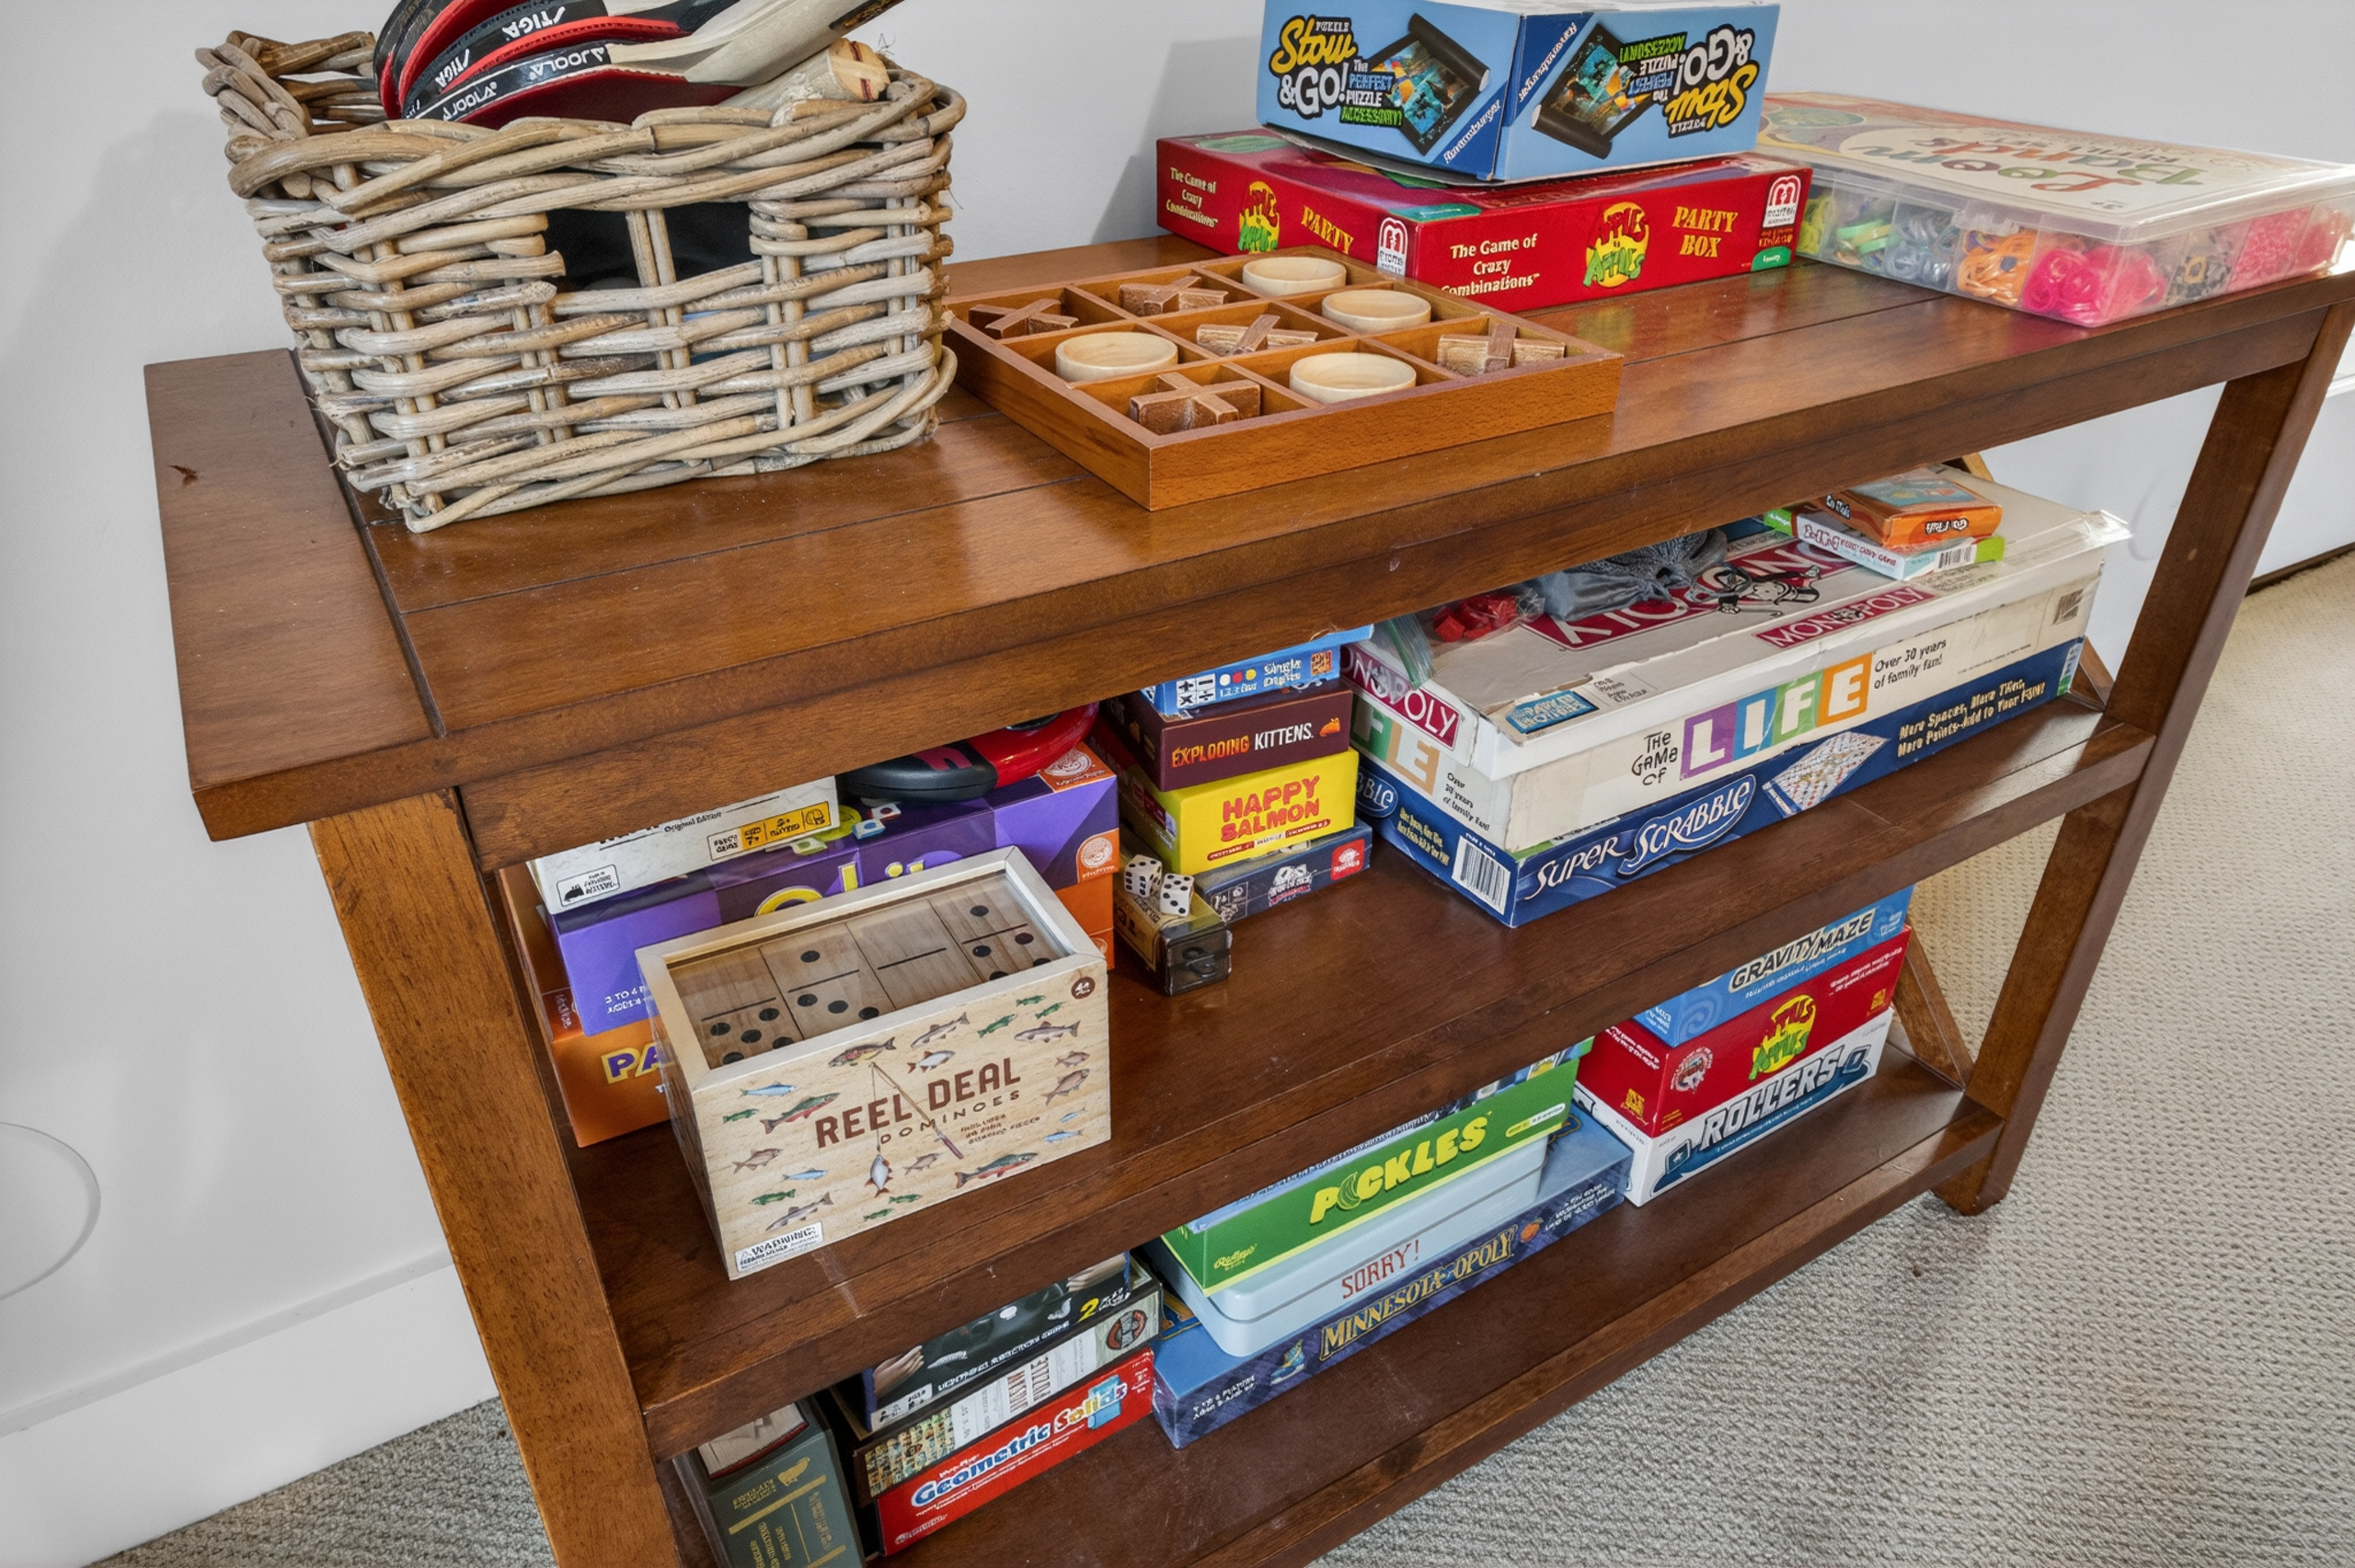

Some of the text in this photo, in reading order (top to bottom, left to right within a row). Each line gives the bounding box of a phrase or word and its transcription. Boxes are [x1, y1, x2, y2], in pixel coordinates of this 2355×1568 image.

[501, 6, 566, 39] STIGA
[1270, 17, 1357, 74] Stow
[435, 48, 470, 88] STIGA
[1346, 89, 1384, 107] PUZZLE
[1664, 63, 1758, 129] Stow
[1301, 204, 1354, 255] PARTY
[1671, 206, 1739, 233] PARTY
[1450, 233, 1538, 259] The Game of
[1473, 258, 1512, 276] Crazy
[1680, 235, 1722, 258] BOX
[1873, 676, 1886, 690] of
[1888, 662, 1921, 686] family
[1875, 657, 1901, 673] Over
[1918, 639, 1947, 658] years
[1687, 660, 1867, 773] LIFE
[1899, 719, 1925, 741] More
[1970, 690, 1996, 710] More
[1171, 735, 1251, 769] EXPLODING
[1632, 747, 1678, 776] GAME
[1643, 731, 1672, 753] THE
[1898, 738, 1924, 758] More
[1642, 768, 1668, 785] OF
[1220, 797, 1321, 842] SALMON
[1222, 774, 1320, 823] HAPPY
[1627, 781, 1751, 869] SCRABBLE
[1523, 836, 1631, 900] SUPER
[814, 1093, 913, 1150] REEL
[927, 1058, 1022, 1112] DEAL
[879, 1089, 1021, 1145] DOMINOES
[1700, 1045, 1845, 1151] ROLLERS
[1340, 1238, 1420, 1300] SORRY!
[911, 1381, 1129, 1508] Geometric Solids
